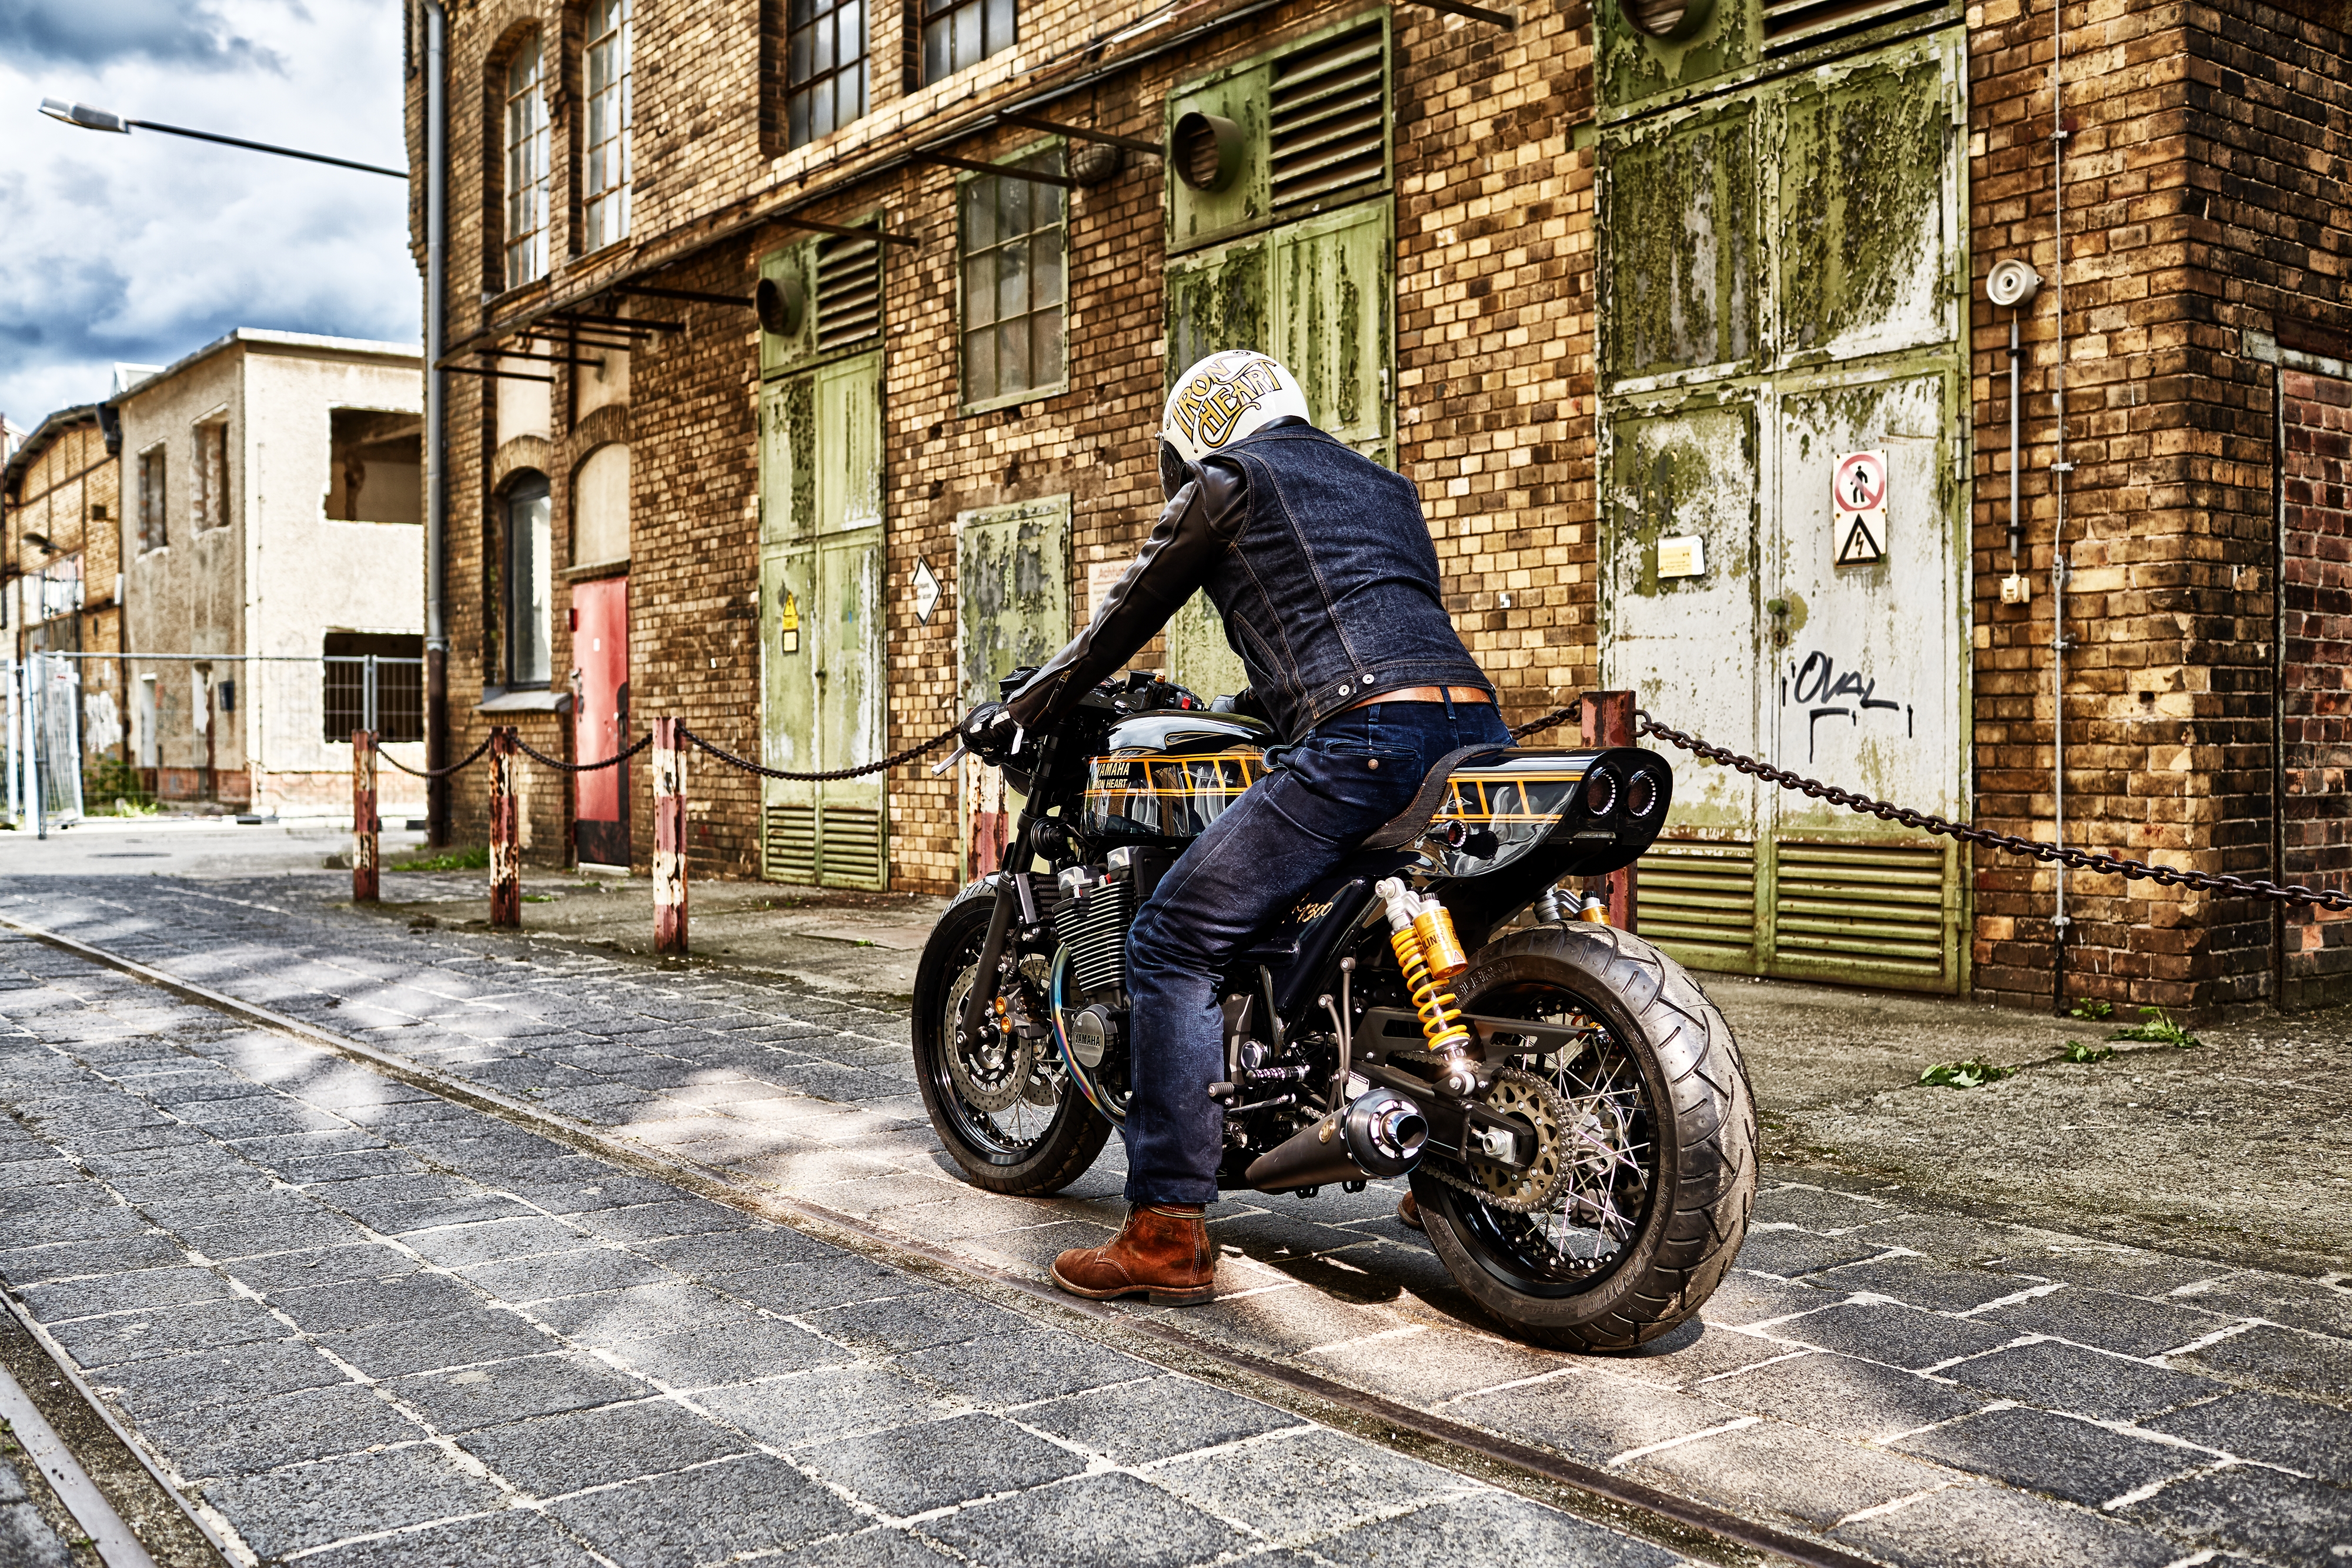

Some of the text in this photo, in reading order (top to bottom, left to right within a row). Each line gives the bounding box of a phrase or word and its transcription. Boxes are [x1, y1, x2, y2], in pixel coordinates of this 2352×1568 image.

[1165, 354, 1248, 445] IRON
[1198, 359, 1282, 448] HEART
[1096, 762, 1130, 777] YAMAHA
[1106, 778, 1128, 789] HEART
[1421, 930, 1445, 951] LINS
[1074, 1031, 1101, 1048] YAMAHA
[980, 1158, 1034, 1175] METZELER
[1577, 1241, 1654, 1318] MARATHON
